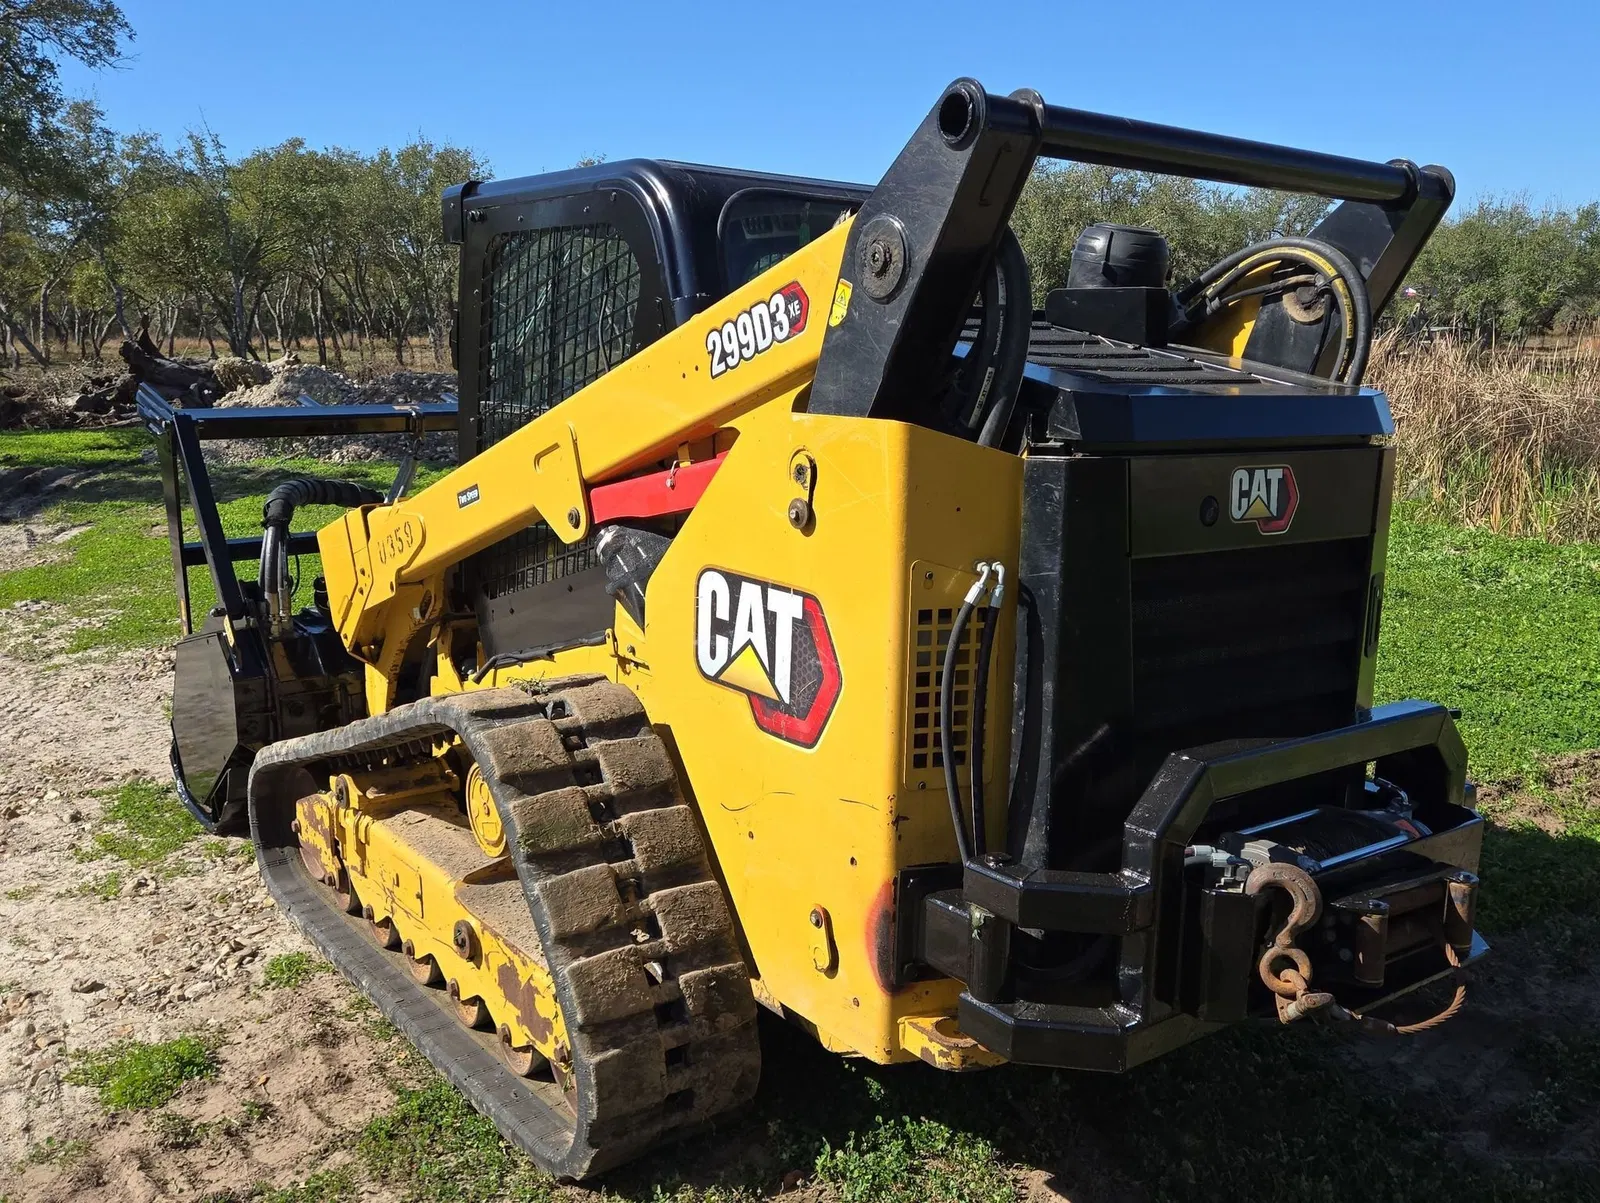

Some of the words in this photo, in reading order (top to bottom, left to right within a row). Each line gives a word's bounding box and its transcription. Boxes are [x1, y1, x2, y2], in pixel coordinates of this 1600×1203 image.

[707, 293, 790, 377] 299D3
[788, 300, 801, 319] XE
[1231, 468, 1284, 520] CAT
[697, 570, 804, 706] CAT
